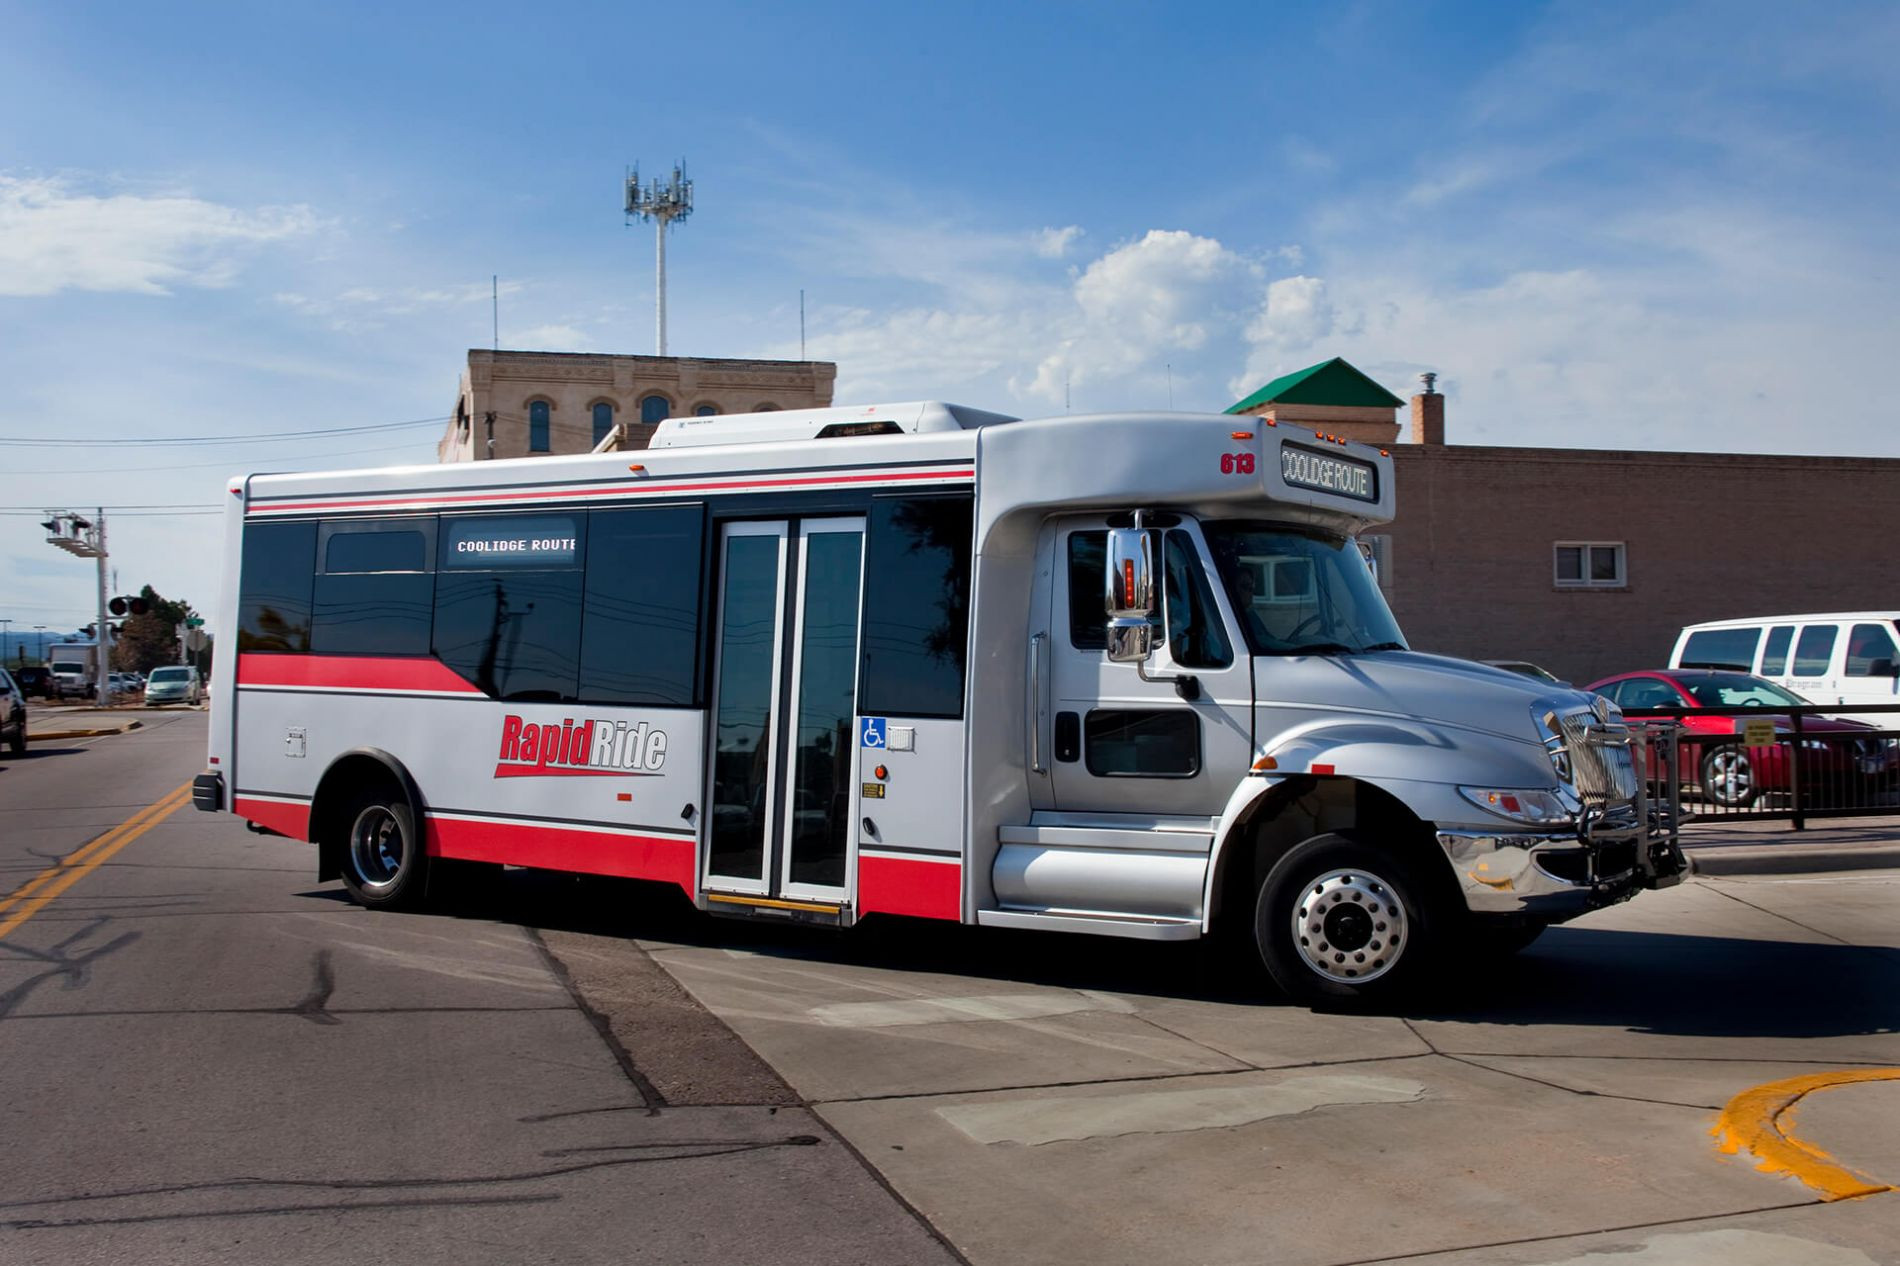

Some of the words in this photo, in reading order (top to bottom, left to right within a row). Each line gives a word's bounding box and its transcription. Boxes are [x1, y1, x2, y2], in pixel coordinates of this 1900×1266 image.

[1220, 452, 1255, 474] 613
[1334, 463, 1367, 495] ROUTE
[457, 540, 527, 552] COOLIDGE
[499, 715, 668, 771] RapidRide
